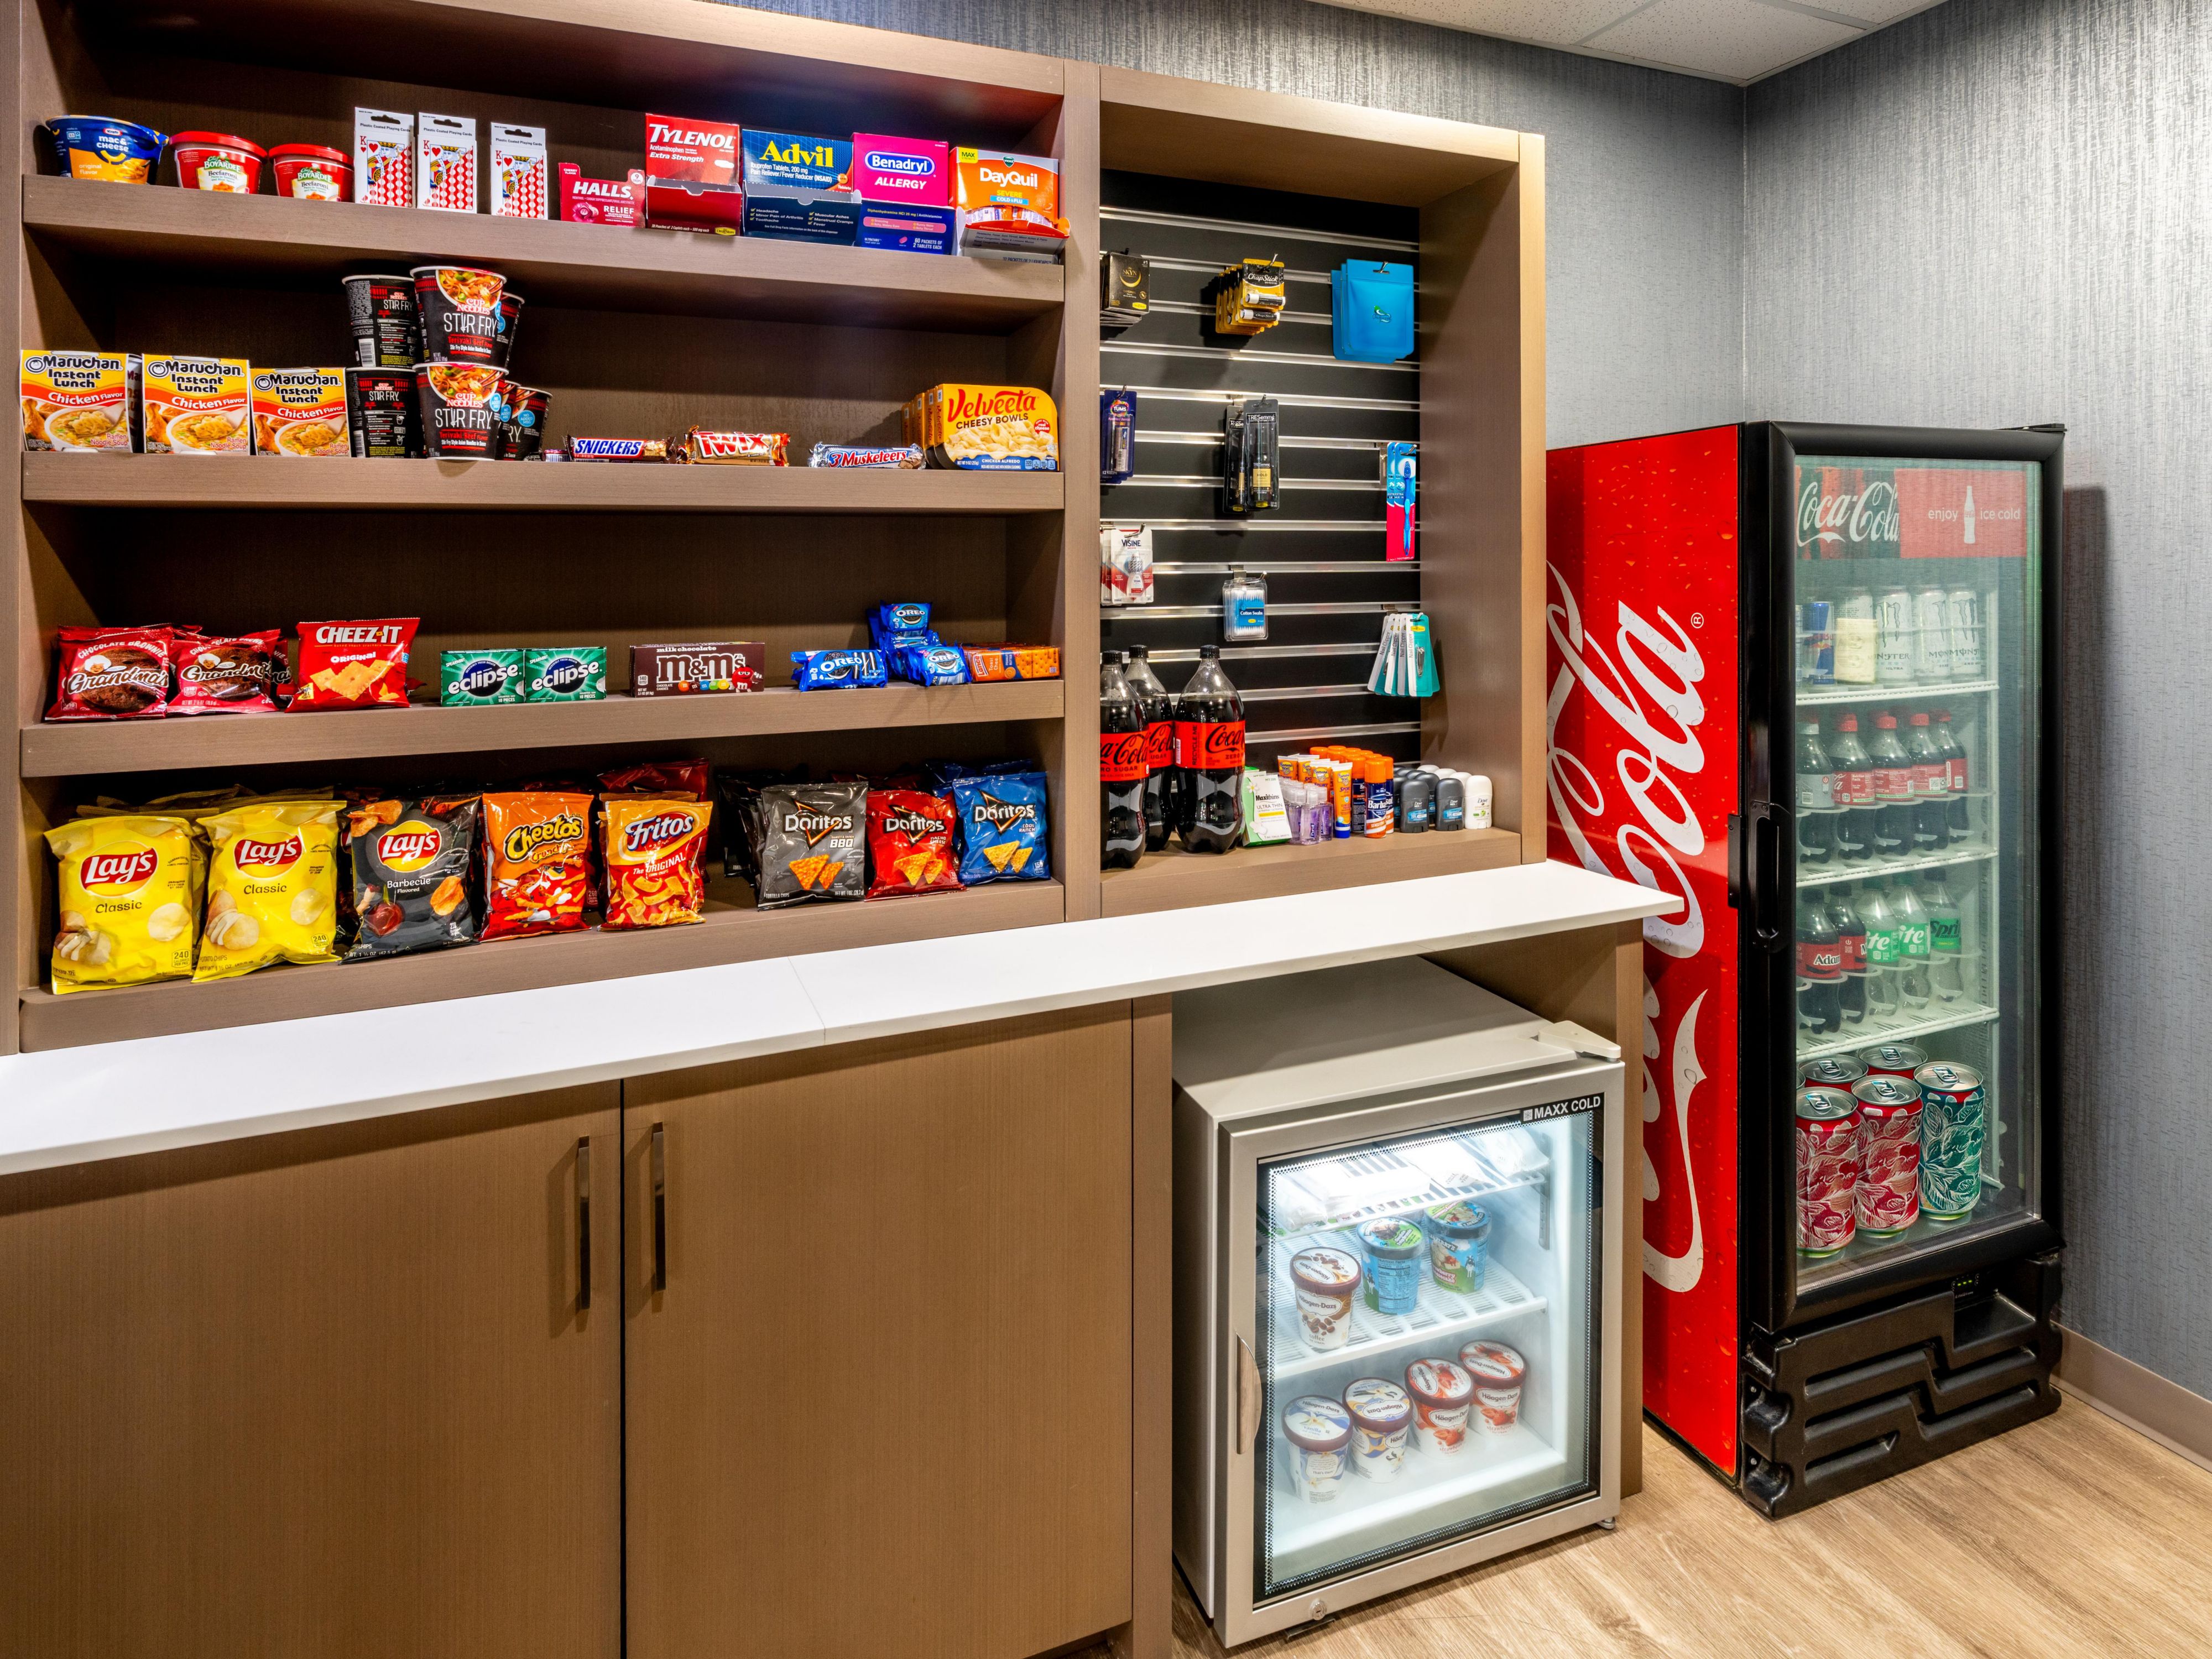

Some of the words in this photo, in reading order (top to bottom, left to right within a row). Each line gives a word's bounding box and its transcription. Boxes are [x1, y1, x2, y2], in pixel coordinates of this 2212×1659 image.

[649, 123, 735, 150] TYLENOL
[649, 144, 685, 154] Acetaminophen
[759, 140, 834, 168] Advil
[649, 152, 671, 160] Extra
[672, 154, 705, 164] Strength
[872, 155, 928, 171] Benadryl
[204, 161, 242, 173] BOYARDEE
[750, 162, 772, 171] Ibuprofen
[773, 164, 790, 173] Tablets,
[208, 170, 238, 180] Beefaroni
[298, 172, 332, 184] BOYARDEE
[761, 169, 794, 179] Reliever/Fever
[794, 172, 813, 180] Reducer
[814, 174, 832, 183] (NSAID)
[979, 167, 1038, 187] DayQuil
[301, 181, 329, 190] Beefaroni
[874, 177, 927, 190] ALLERGY
[997, 190, 1022, 198] SEVERE
[603, 205, 634, 215] RELIEF
[1248, 273, 1279, 283] ChapStick
[466, 297, 486, 306] CUP
[457, 303, 492, 316] NOODLES
[444, 312, 476, 335] STIR
[478, 315, 499, 337] FRY
[44, 356, 120, 370] Maruchan
[164, 361, 241, 376] Maruchan
[49, 369, 102, 379] Instant
[171, 374, 223, 384] Instant
[269, 374, 338, 385] Maruchan
[54, 378, 96, 388] Lunch
[178, 383, 218, 393] Lunch
[275, 386, 323, 395] Instant
[455, 391, 477, 400] CUP
[49, 392, 101, 404] Chicken
[171, 396, 223, 409] Chicken
[281, 395, 319, 403] Lunch
[446, 398, 484, 408] NOODLES
[947, 389, 1037, 422] Velveeta
[277, 408, 324, 419] Chicken
[435, 408, 465, 430] STIR
[469, 408, 495, 430] FRY
[956, 418, 993, 430] CHEESY
[995, 413, 1029, 425] BOWLS
[575, 440, 643, 456] SNICKERS
[830, 454, 842, 468] 3
[842, 450, 908, 467] Musketeers
[1928, 508, 1959, 522] enjoy
[1980, 508, 1995, 520] ice
[1997, 507, 2021, 520] cold
[895, 609, 926, 618] OREO
[316, 625, 403, 644] CHEEZ-IT
[1382, 632, 1391, 646] Clipper
[78, 641, 126, 659] CHOCOLATE
[128, 640, 165, 658] BROWNIE
[445, 658, 466, 667] SPEARMINT
[529, 655, 549, 664] SPEARMINT
[928, 653, 961, 662] OREO
[656, 653, 745, 684] m&m's
[820, 656, 863, 674] OREO
[974, 654, 984, 676] Lance
[67, 666, 170, 695] Grandma's
[448, 664, 519, 695] eclipse
[531, 661, 601, 692] eclipse
[1192, 726, 1198, 735] ME
[974, 805, 1036, 822] Doritos
[785, 814, 853, 832] Doritos
[886, 818, 945, 833] Doritos
[507, 814, 582, 859] Cheetos
[624, 815, 694, 852] Fritos
[382, 831, 438, 864] Lay's
[830, 838, 854, 848] BBQ
[238, 838, 298, 867] Lay's
[85, 851, 154, 885] Lay's
[645, 852, 686, 874] ORIGINAL
[243, 883, 288, 895] Classic
[387, 877, 432, 889] Barbecue
[95, 900, 143, 914] Classic
[1929, 919, 1959, 940] Spri
[174, 950, 190, 960] 240
[1534, 1102, 1568, 1120] MAXX
[1571, 1095, 1601, 1112] COLD
[1297, 1295, 1337, 1310] Häagen-Dazs
[1481, 1391, 1519, 1403] Häagen-Dazs
[1301, 1399, 1340, 1415] Häagen-Dazs
[1303, 1425, 1322, 1434] vanilla
